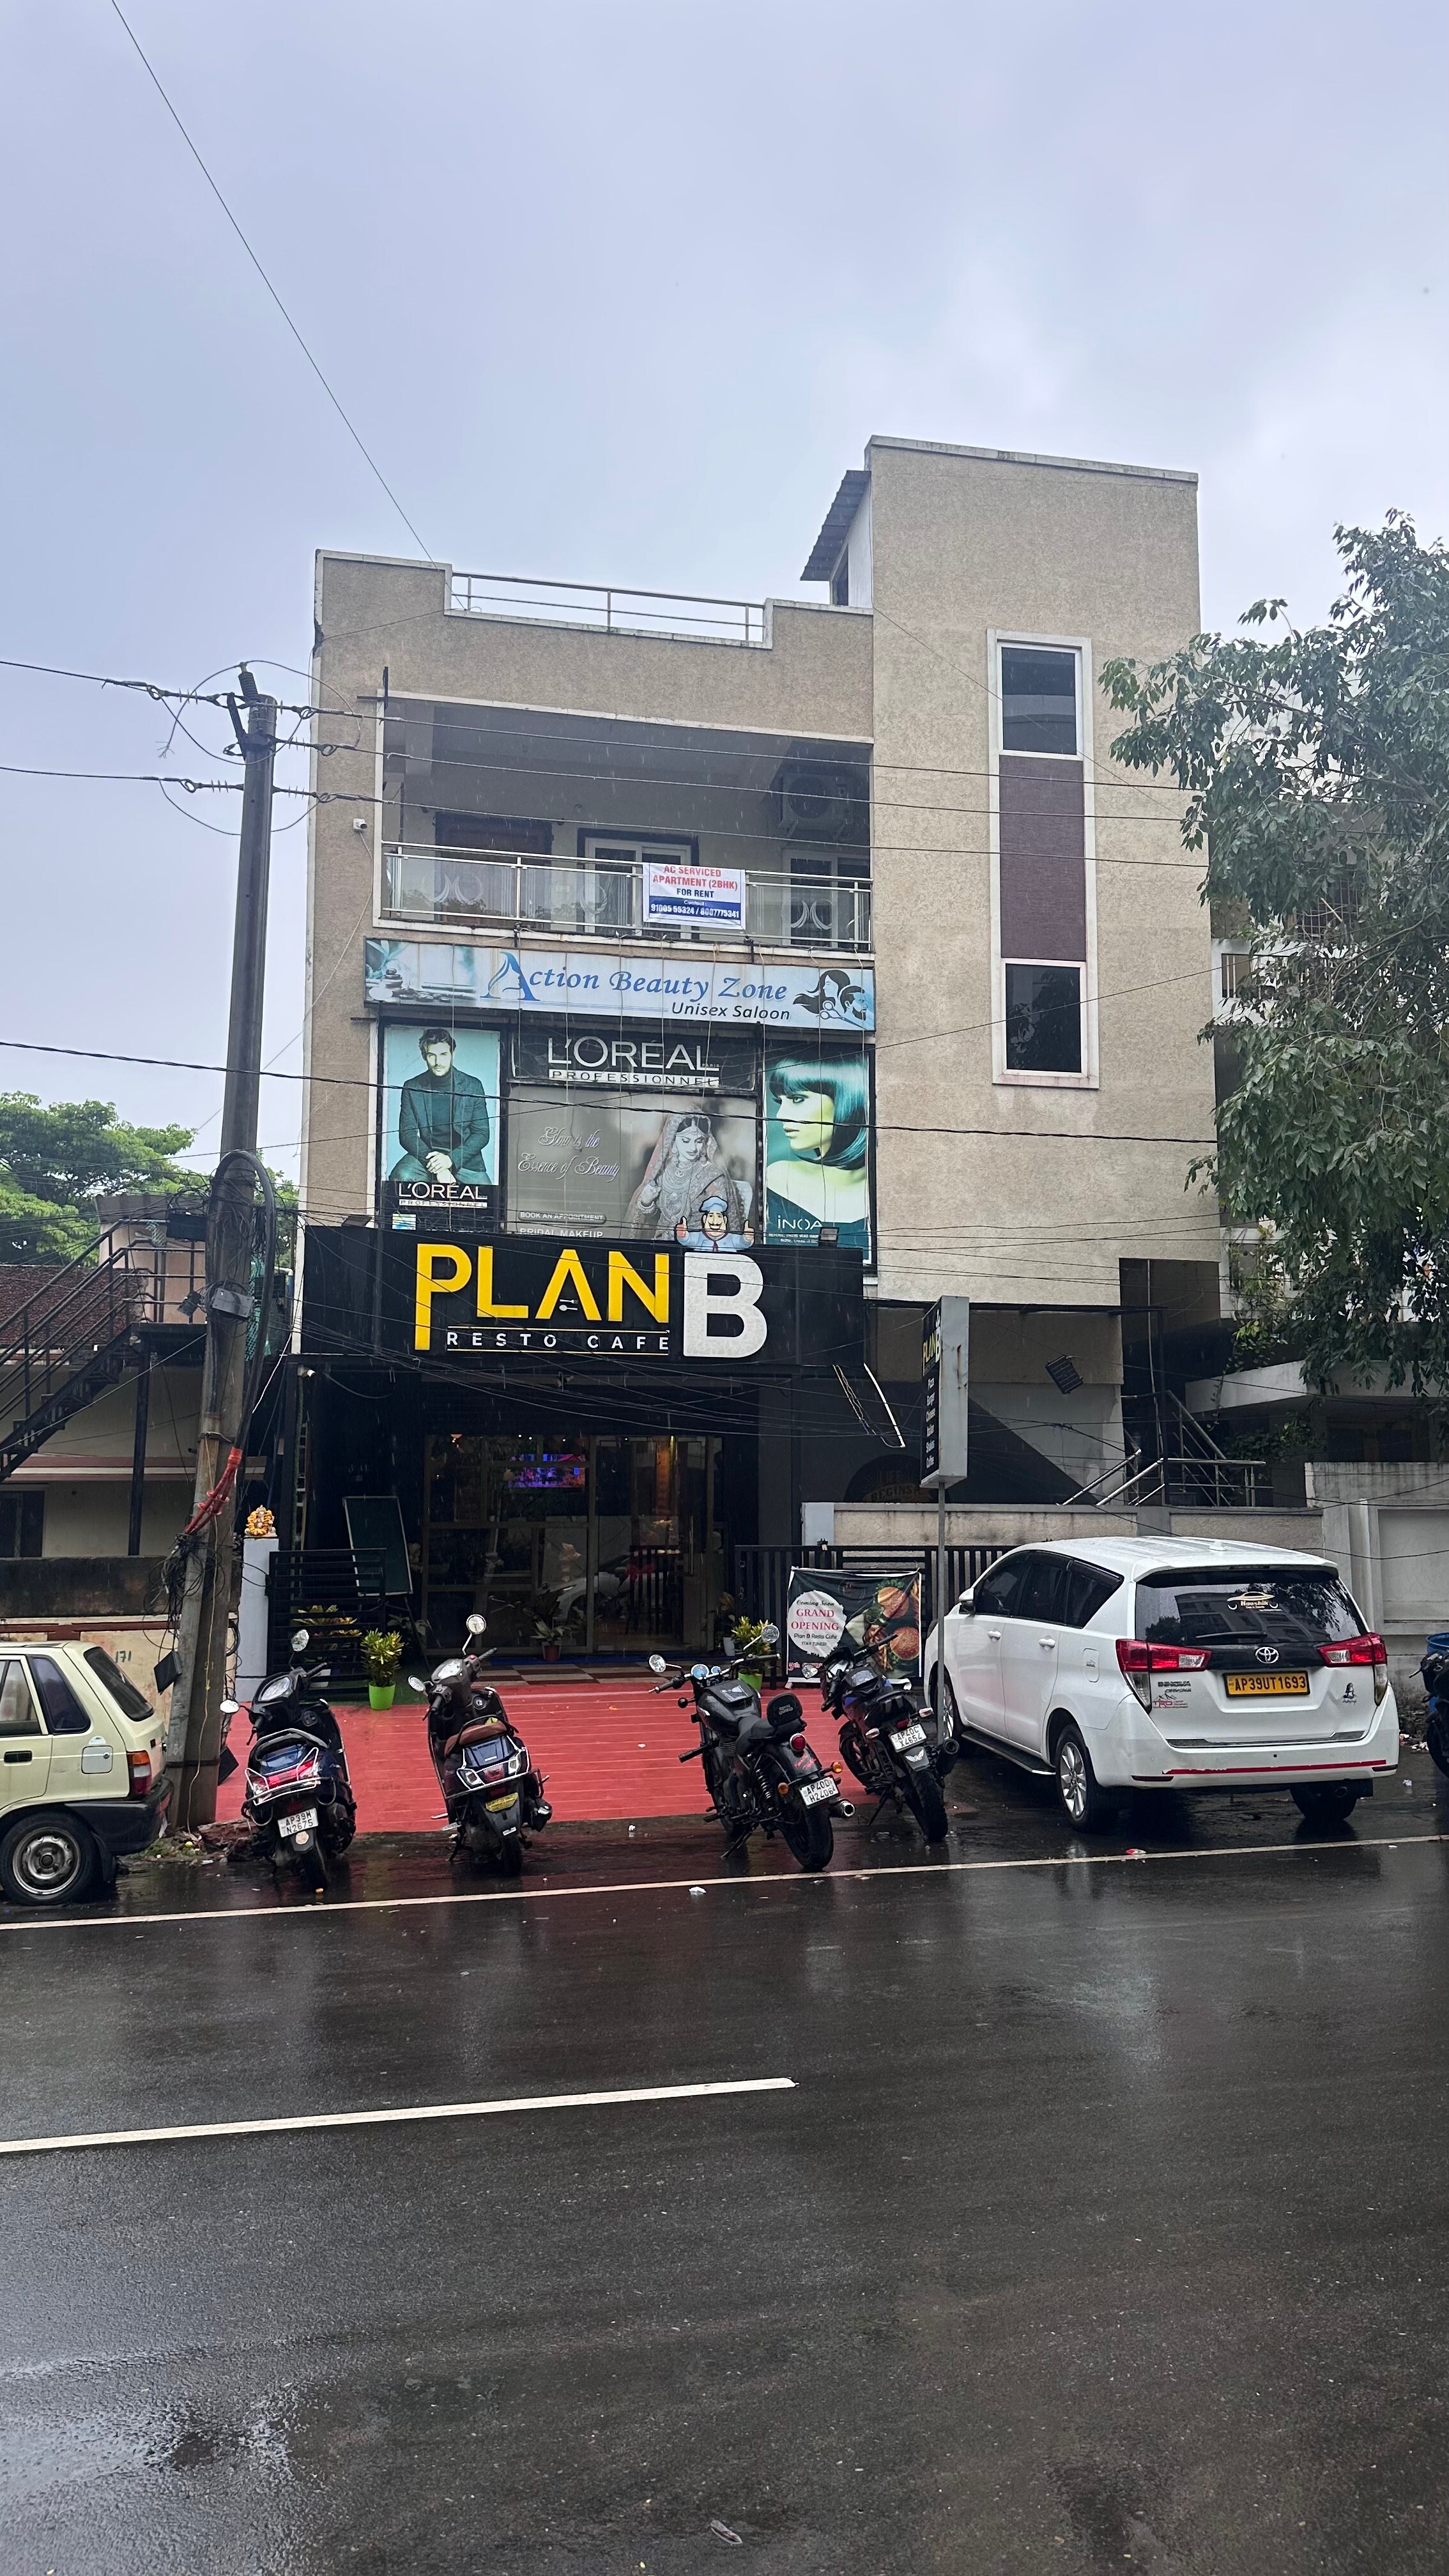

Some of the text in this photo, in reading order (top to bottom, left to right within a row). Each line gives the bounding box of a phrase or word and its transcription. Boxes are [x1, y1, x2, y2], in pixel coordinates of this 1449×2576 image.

[663, 865, 721, 877] AC SERVICED
[653, 875, 738, 891] APARTMENT (2BHK)
[677, 888, 714, 898] FOR RENT
[480, 951, 787, 1002] Action Beauty Zone
[672, 1002, 790, 1020] Unisex Saloon
[548, 1036, 719, 1071] L'ORÉAL
[552, 1071, 716, 1086] PROFESSIONNEL
[538, 1127, 601, 1147] Glow is the
[518, 1153, 620, 1183] Essence of Beauty
[399, 1182, 487, 1200] L'ORÉAL
[401, 1199, 485, 1208] PROFESSIONNEL
[560, 1229, 603, 1238] MAKEUP
[683, 1252, 767, 1358] B
[447, 1331, 669, 1350] RESTO CAFE
[797, 1608, 834, 1617] GRAND
[791, 1621, 839, 1630] OPENING
[116, 1650, 132, 1663] 171
